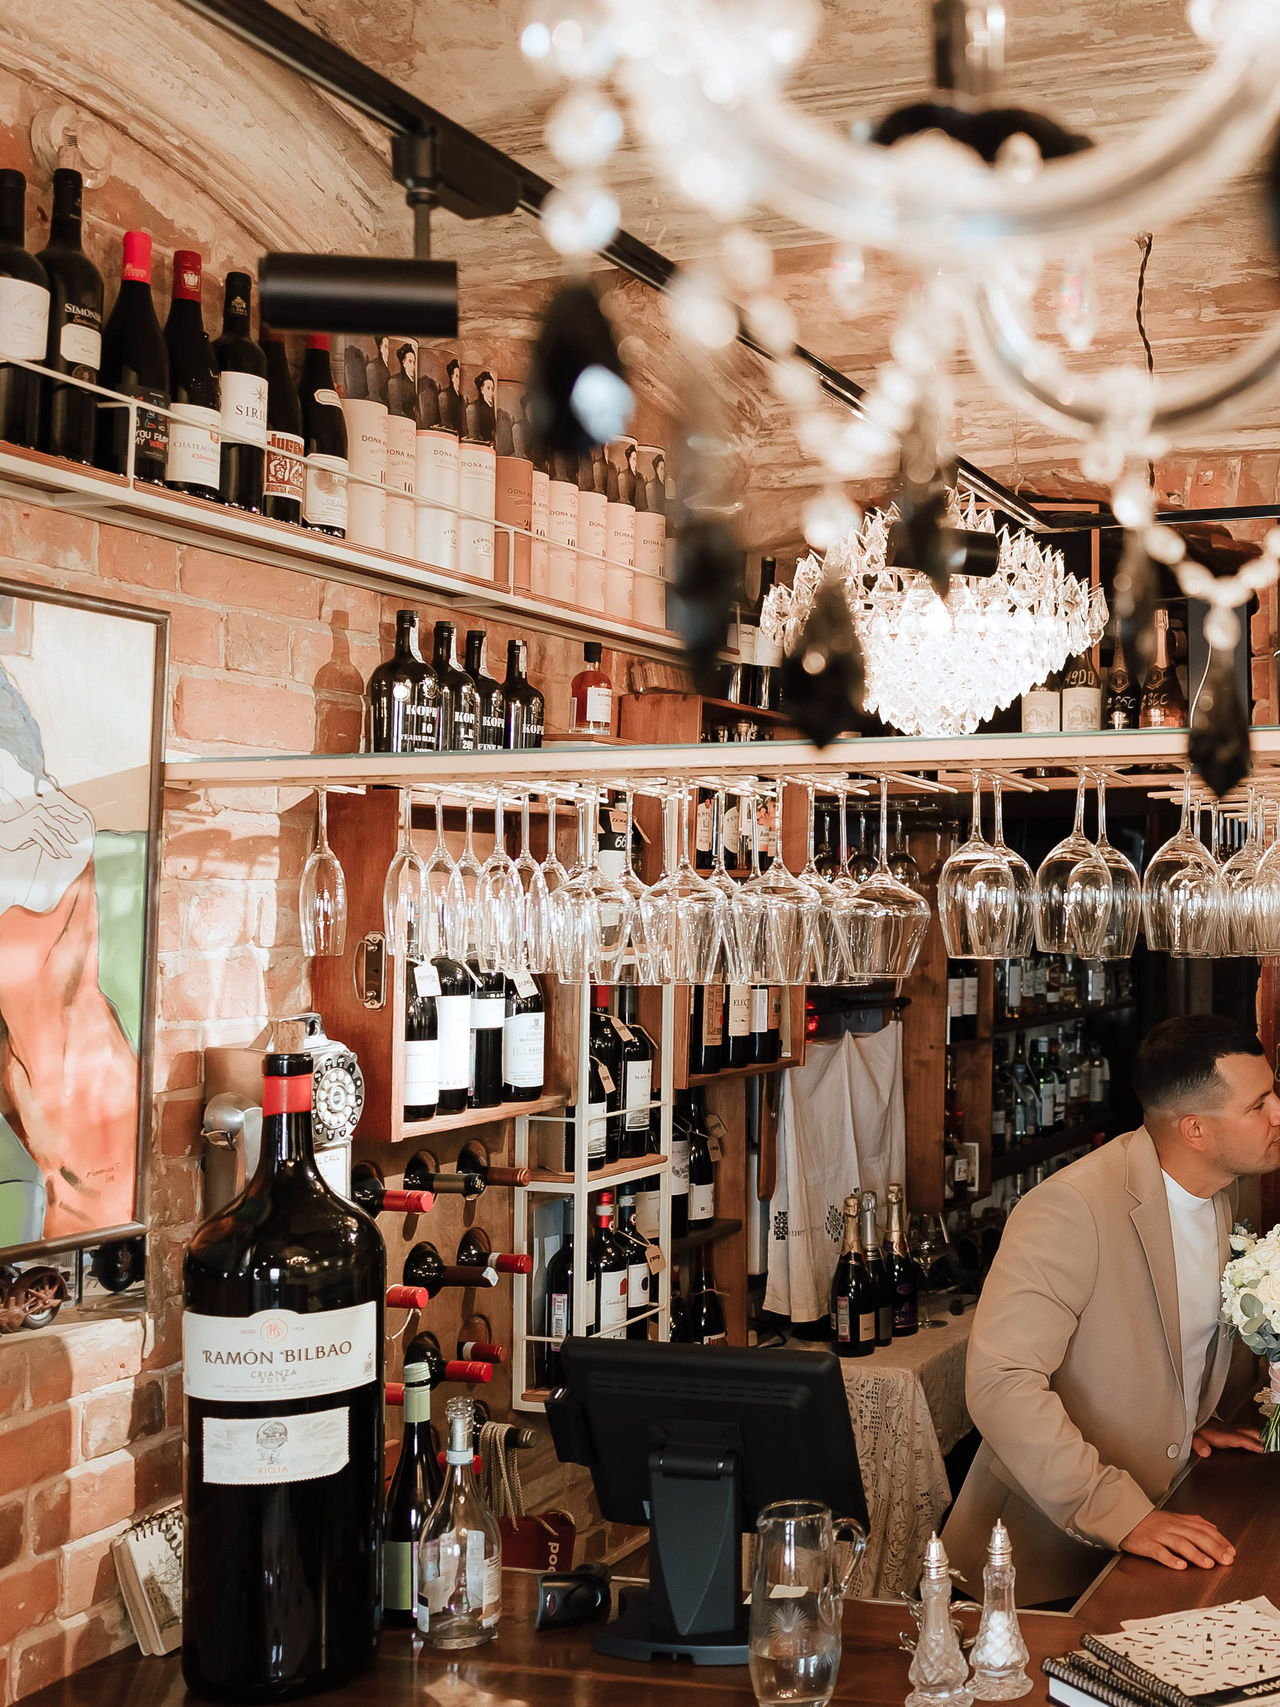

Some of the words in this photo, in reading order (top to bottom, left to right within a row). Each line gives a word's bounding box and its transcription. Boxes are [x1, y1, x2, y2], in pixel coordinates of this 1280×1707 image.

[361, 435, 381, 445] DONA
[433, 449, 452, 457] DONA
[421, 722, 433, 734] 10
[280, 1340, 353, 1363] BILBAO
[250, 1369, 297, 1379] CRIANZA
[258, 1466, 288, 1474] RIOJA
